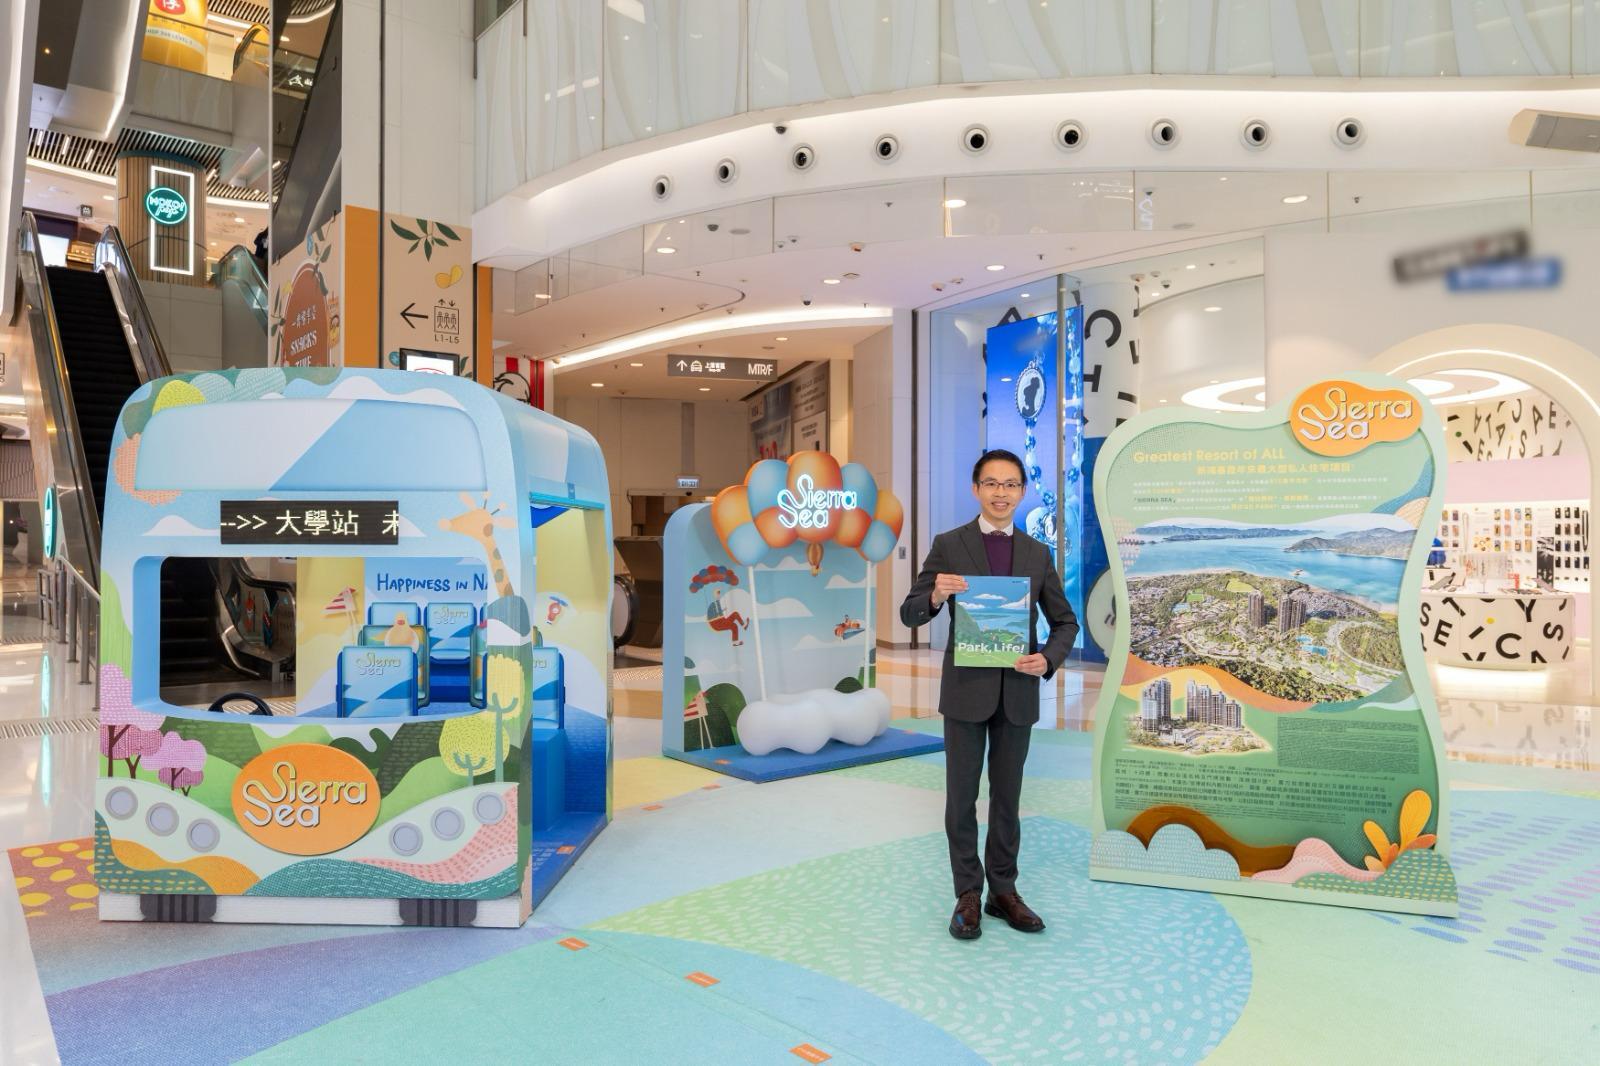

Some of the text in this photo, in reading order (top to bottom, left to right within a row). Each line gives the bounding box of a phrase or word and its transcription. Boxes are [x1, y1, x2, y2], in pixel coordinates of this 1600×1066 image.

[290, 329, 317, 355] SNACKS
[434, 334, 460, 344] L1-L5
[1300, 387, 1413, 421] Sierra
[1298, 406, 1370, 441] Sea
[1133, 447, 1286, 463] Greatest Resort of ALL
[779, 474, 858, 510] Sierra
[275, 509, 359, 536] 大學站
[777, 491, 829, 528] Sea
[473, 573, 488, 592] N
[355, 651, 401, 668] Sierra
[958, 642, 1025, 654] Park, Life!
[244, 761, 368, 805] Sierra
[242, 781, 320, 828] Sea
